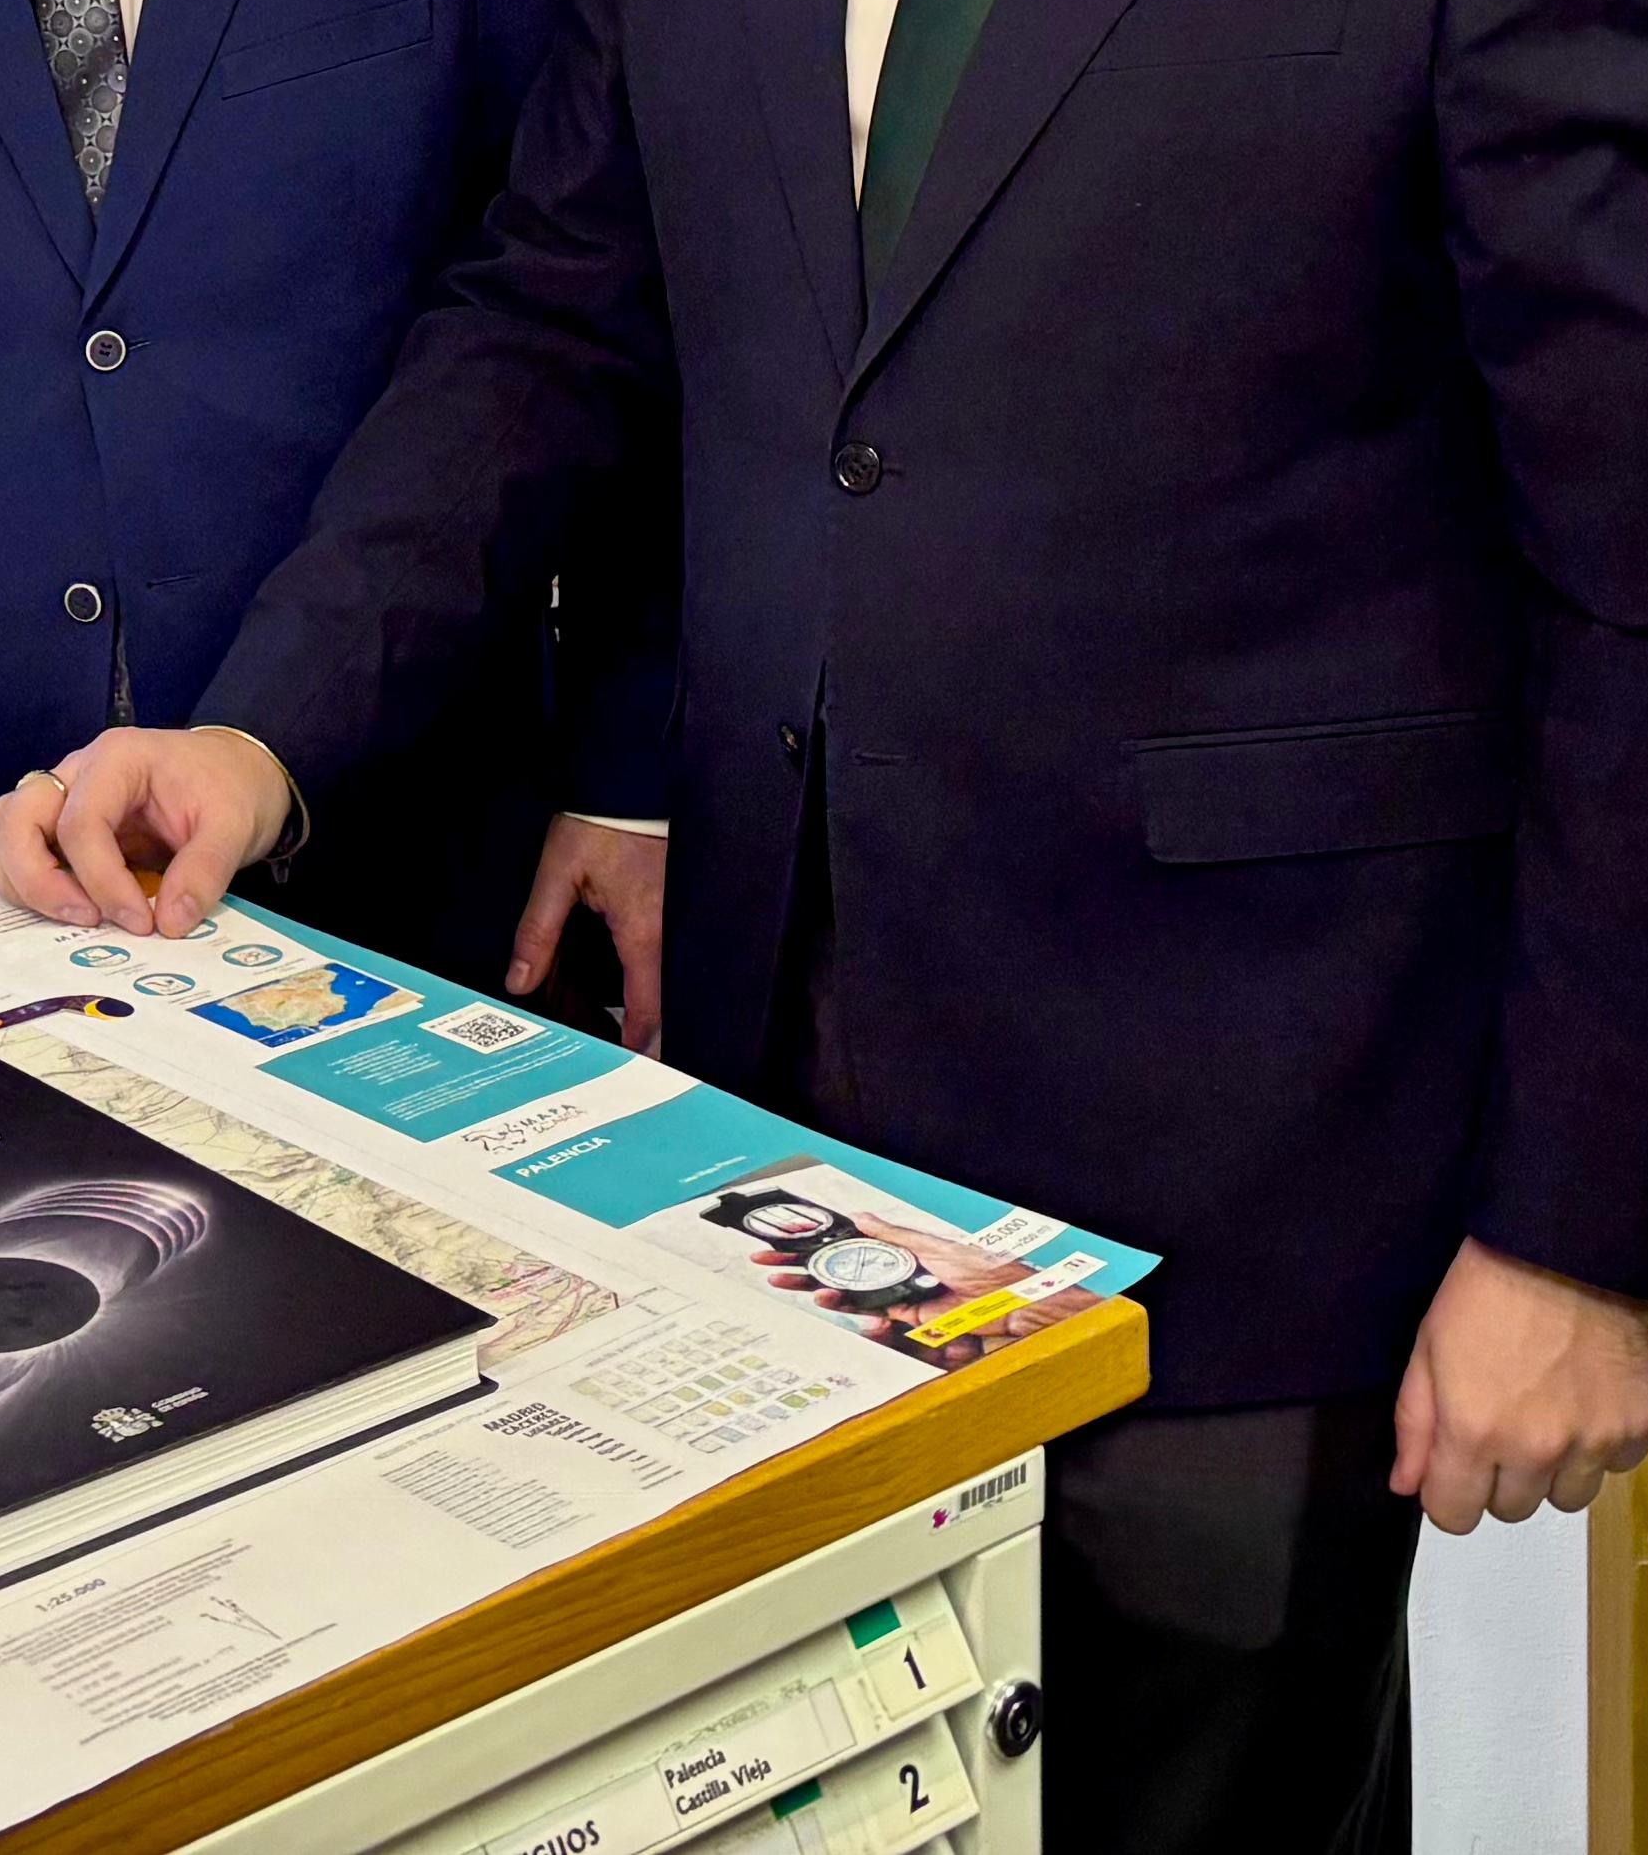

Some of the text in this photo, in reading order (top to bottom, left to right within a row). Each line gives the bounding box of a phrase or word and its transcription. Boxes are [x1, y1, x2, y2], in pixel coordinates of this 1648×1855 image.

[514, 1134, 613, 1179] PALENCIA
[482, 1401, 548, 1433] MADRID
[903, 1645, 927, 1690] 1
[664, 1747, 727, 1790] Palencia
[675, 1755, 773, 1816] Castilla Vieja
[898, 1763, 931, 1814] 2
